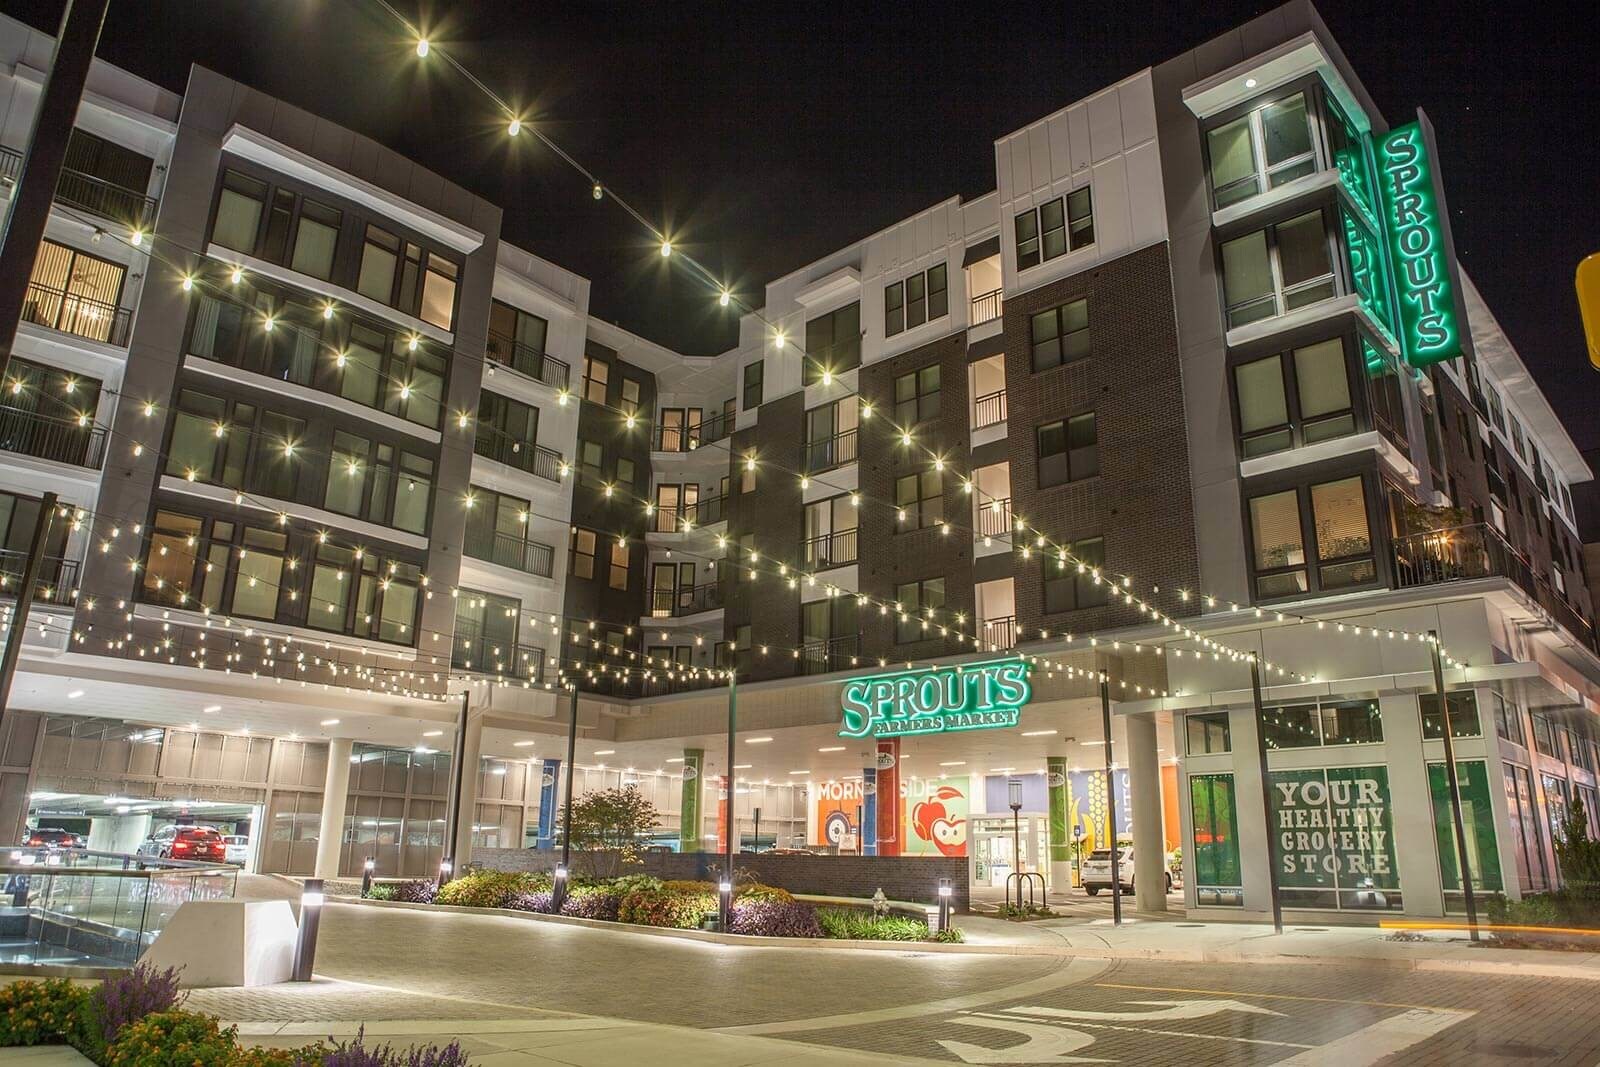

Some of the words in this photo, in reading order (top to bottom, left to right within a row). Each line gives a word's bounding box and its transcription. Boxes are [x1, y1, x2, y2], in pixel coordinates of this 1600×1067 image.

[1384, 131, 1449, 351] SPROUTS
[839, 664, 1028, 737] SPROUTS
[875, 717, 942, 734] FARMERS
[946, 708, 1018, 728] MARKET
[1276, 779, 1383, 806] YOUR
[1279, 808, 1383, 828] HEALTHY
[1281, 831, 1386, 850] GROCERY
[1283, 854, 1390, 873] STORE
